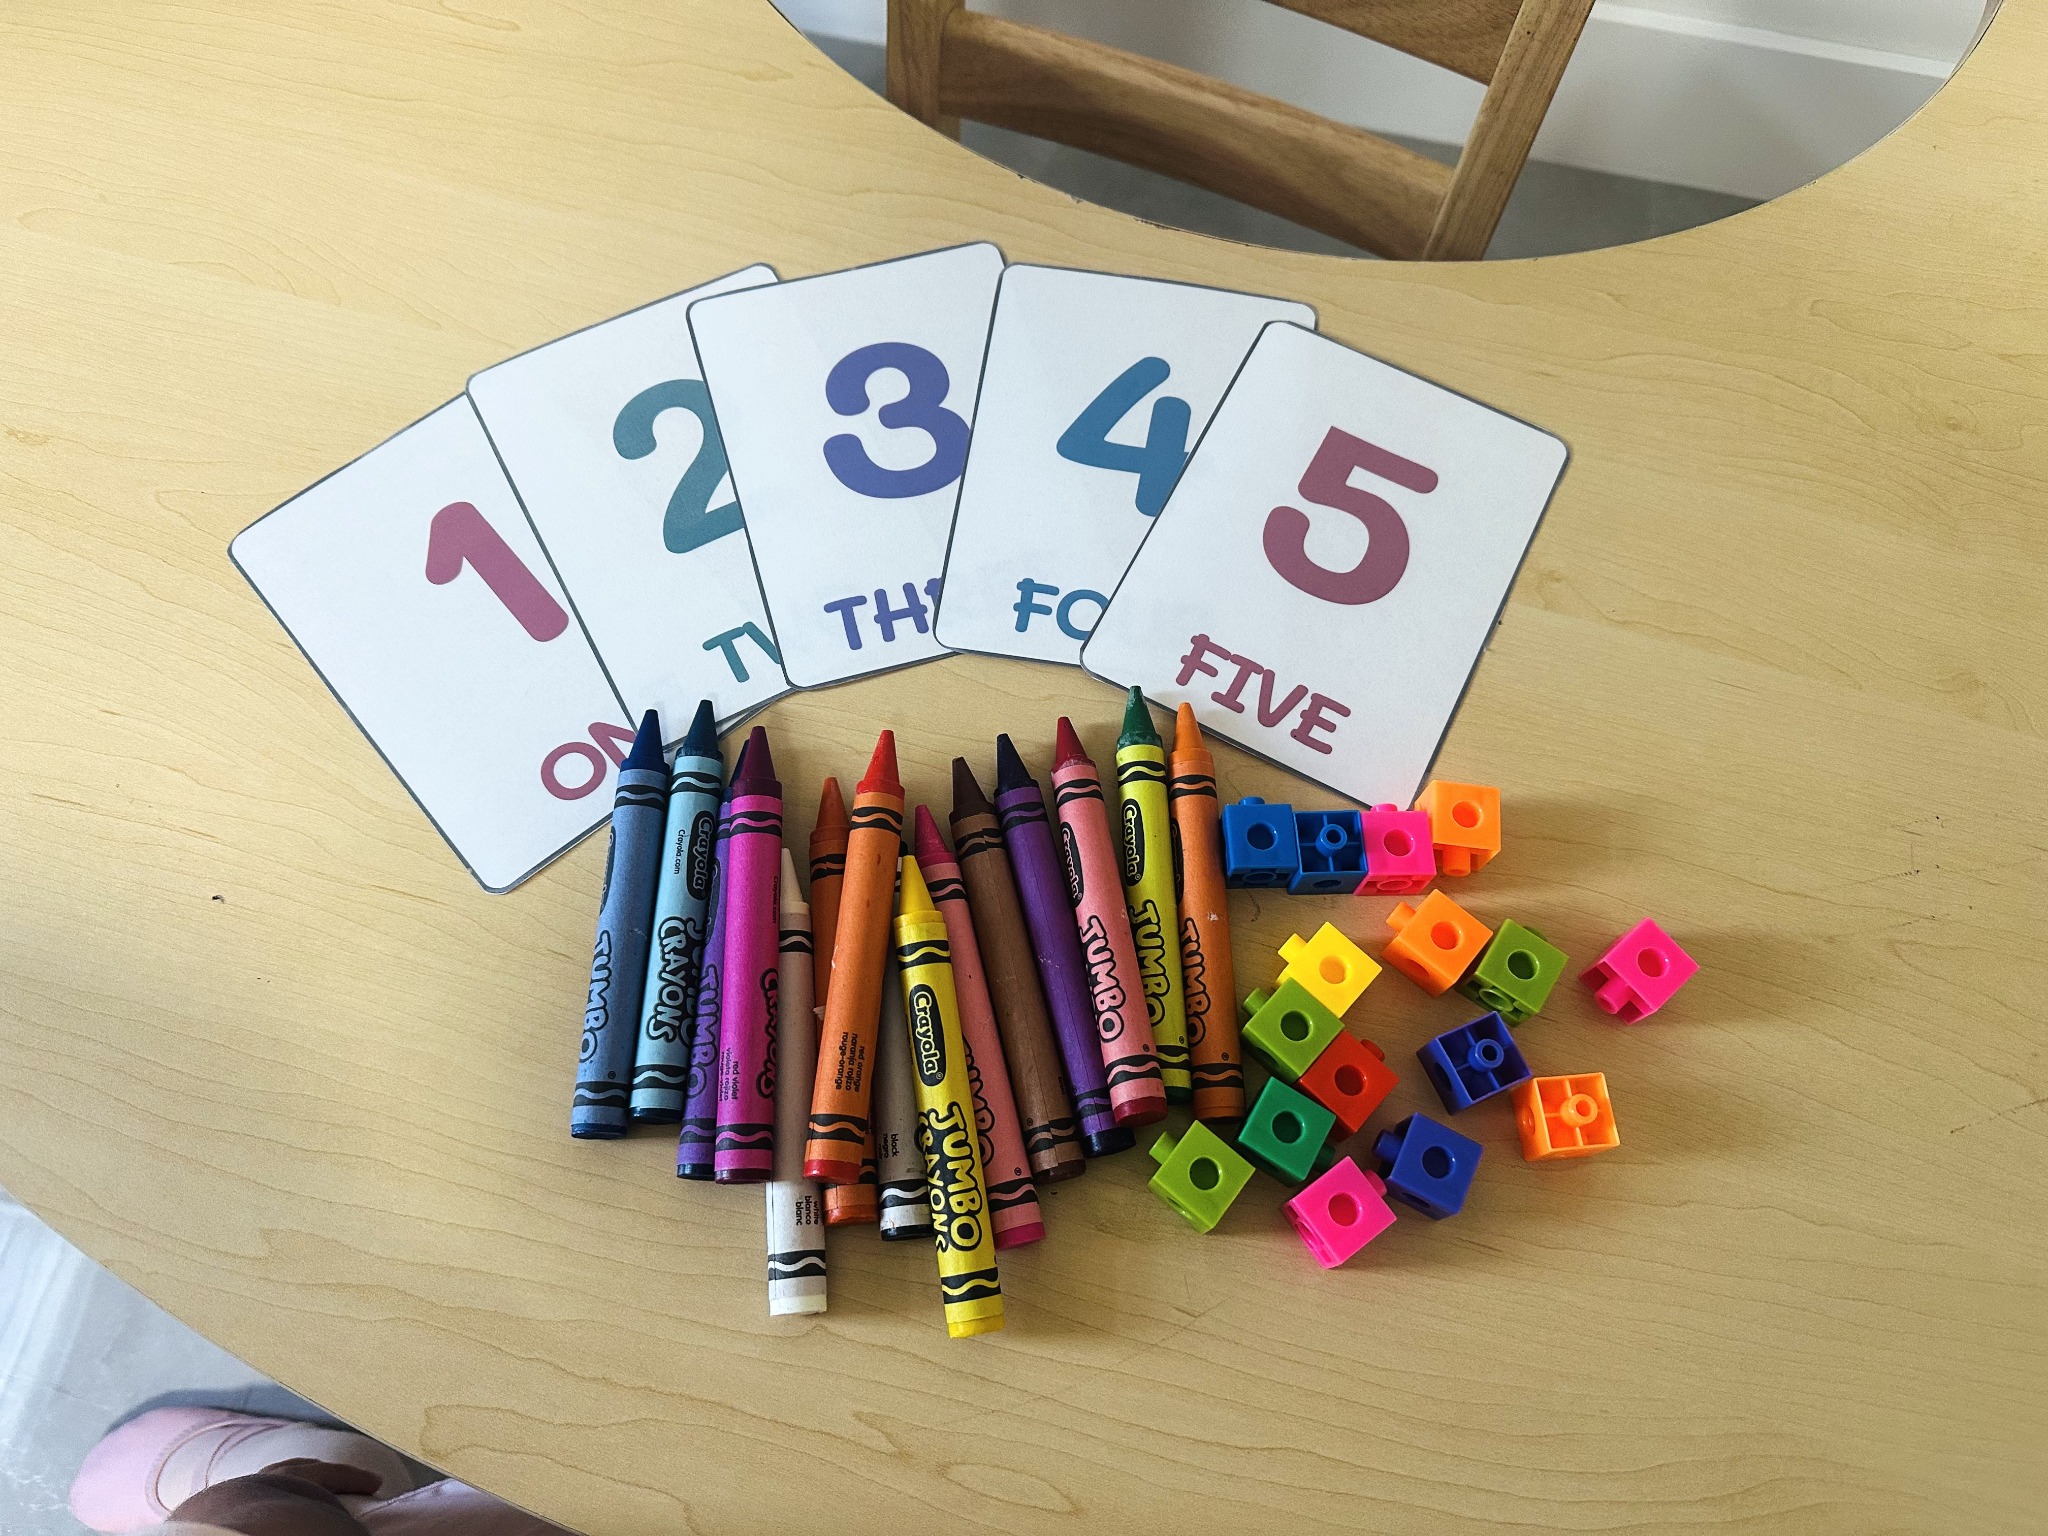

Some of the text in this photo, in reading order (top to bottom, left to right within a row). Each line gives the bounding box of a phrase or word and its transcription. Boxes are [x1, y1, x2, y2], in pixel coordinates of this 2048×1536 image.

[823, 342, 970, 498] 3
[1056, 357, 1191, 517] 4
[613, 379, 745, 553] 2
[1263, 425, 1438, 605] 5
[426, 502, 569, 642] 1
[824, 578, 943, 650] TH
[1013, 577, 1111, 640] FO
[702, 622, 781, 684] T
[1176, 633, 1351, 755] FIVE
[673, 829, 686, 875] Crayola.com
[692, 816, 714, 891] Crayola
[1125, 804, 1142, 875] Crayola
[648, 915, 689, 1043] CRAYONS
[1080, 915, 1126, 1043] JUMBO
[835, 1031, 849, 1090] rouge-orange
[845, 1033, 859, 1091] naranja rojizo
[853, 1045, 866, 1092] red orange
[913, 992, 938, 1075] Crayola
[731, 1060, 740, 1100] red violet
[882, 1133, 890, 1159] negro
[891, 1133, 900, 1158] black
[929, 1101, 983, 1251] JUMBO
[795, 1201, 804, 1226] blanc
[804, 1195, 813, 1225] blanco
